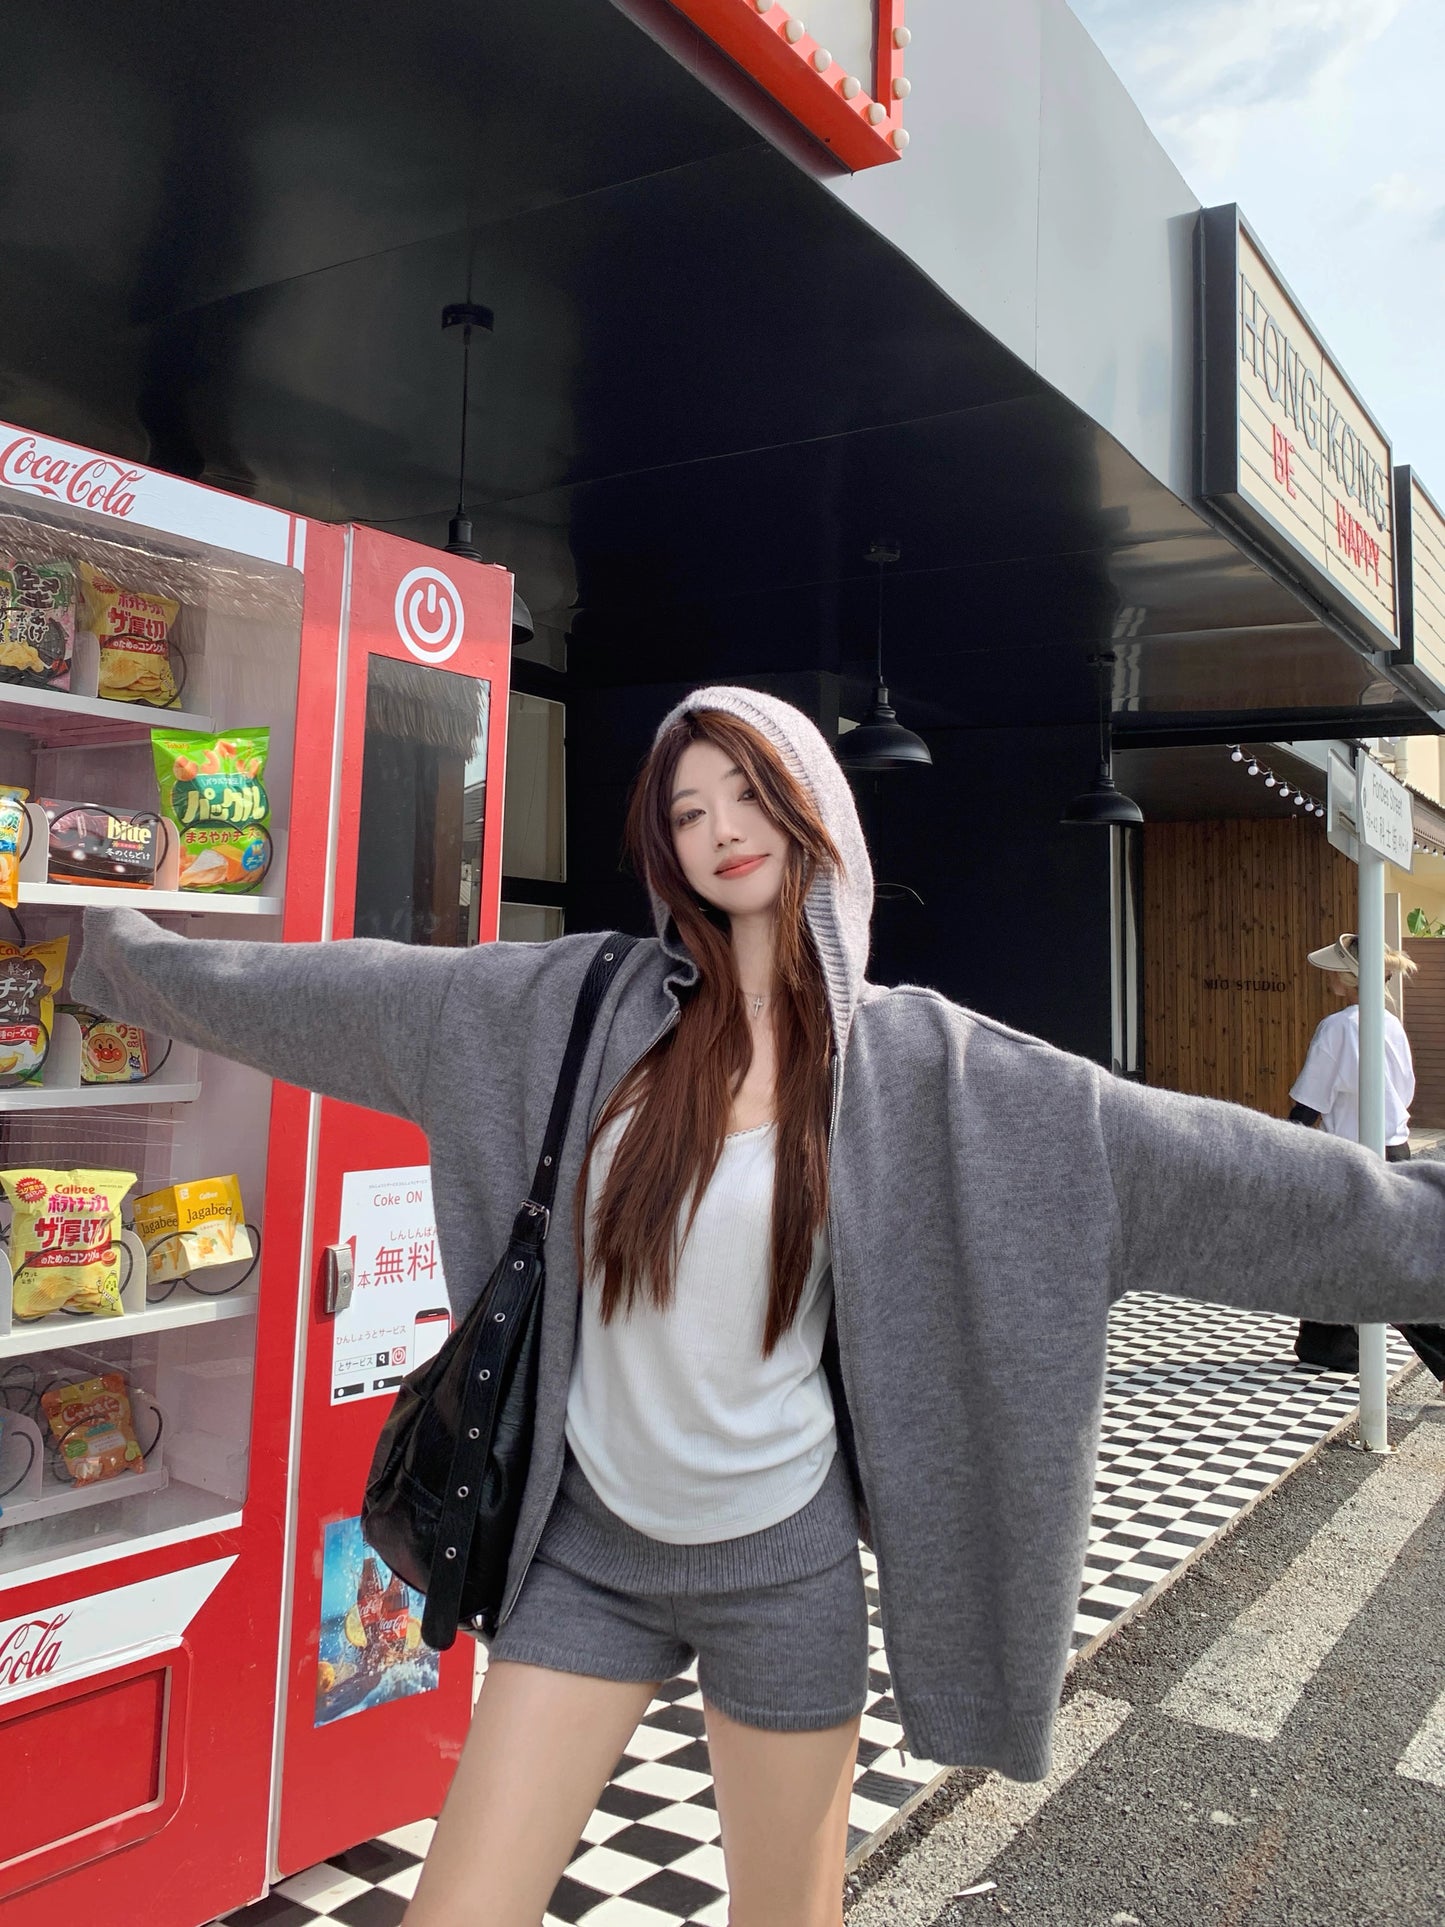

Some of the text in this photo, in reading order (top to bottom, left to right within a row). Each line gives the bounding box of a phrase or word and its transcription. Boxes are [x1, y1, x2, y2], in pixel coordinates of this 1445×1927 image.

[1241, 272, 1387, 533] HONG KONG
[0, 436, 147, 517] Coca-Cola
[1272, 423, 1379, 587] BE HAPPY
[1236, 980, 1286, 993] STUDIO
[54, 1184, 96, 1195] Calbee
[373, 1190, 423, 1207] Coke ON
[186, 1203, 232, 1223] Jagabee
[141, 1216, 179, 1238] Jagabee
[338, 1360, 374, 1372] とサービス
